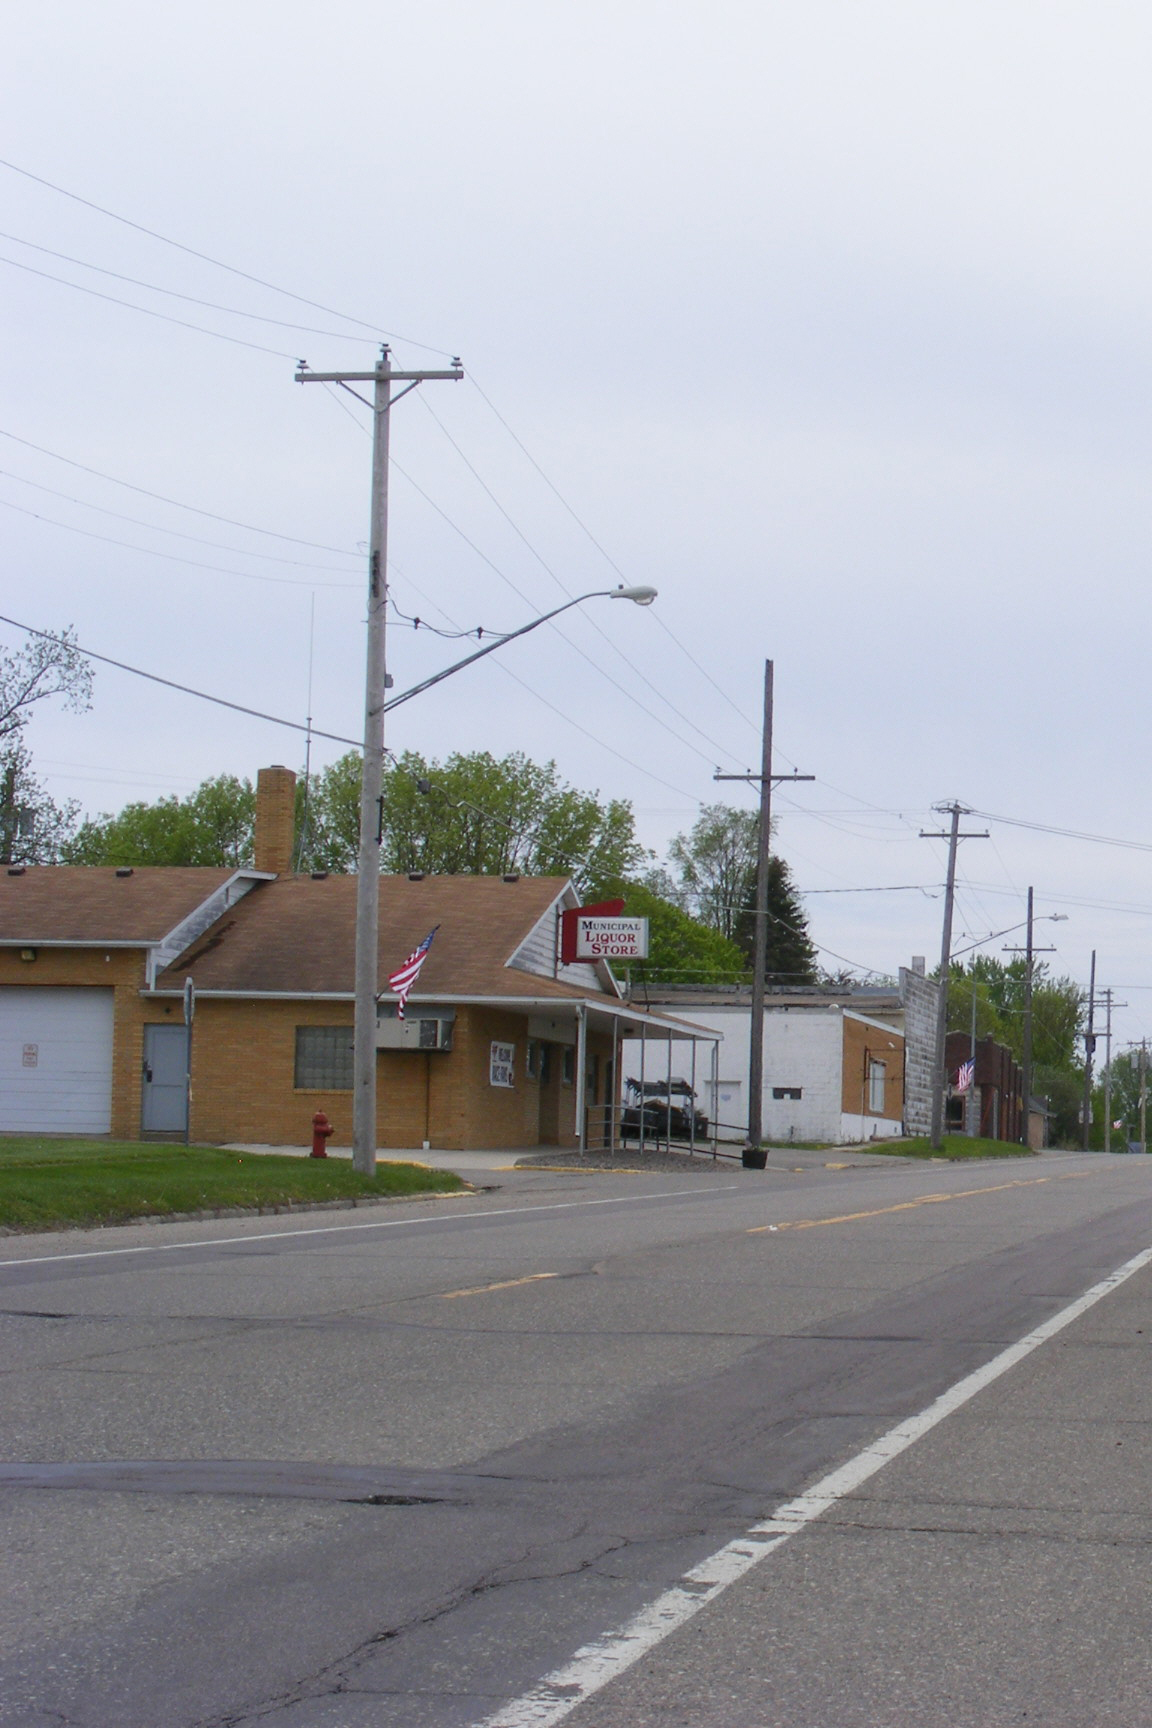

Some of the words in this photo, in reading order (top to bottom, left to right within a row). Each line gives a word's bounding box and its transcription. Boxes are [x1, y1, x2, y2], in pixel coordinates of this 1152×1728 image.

[581, 920, 641, 930] MUNICIPAL
[585, 931, 636, 944] LIQUOR
[591, 942, 638, 955] STORE
